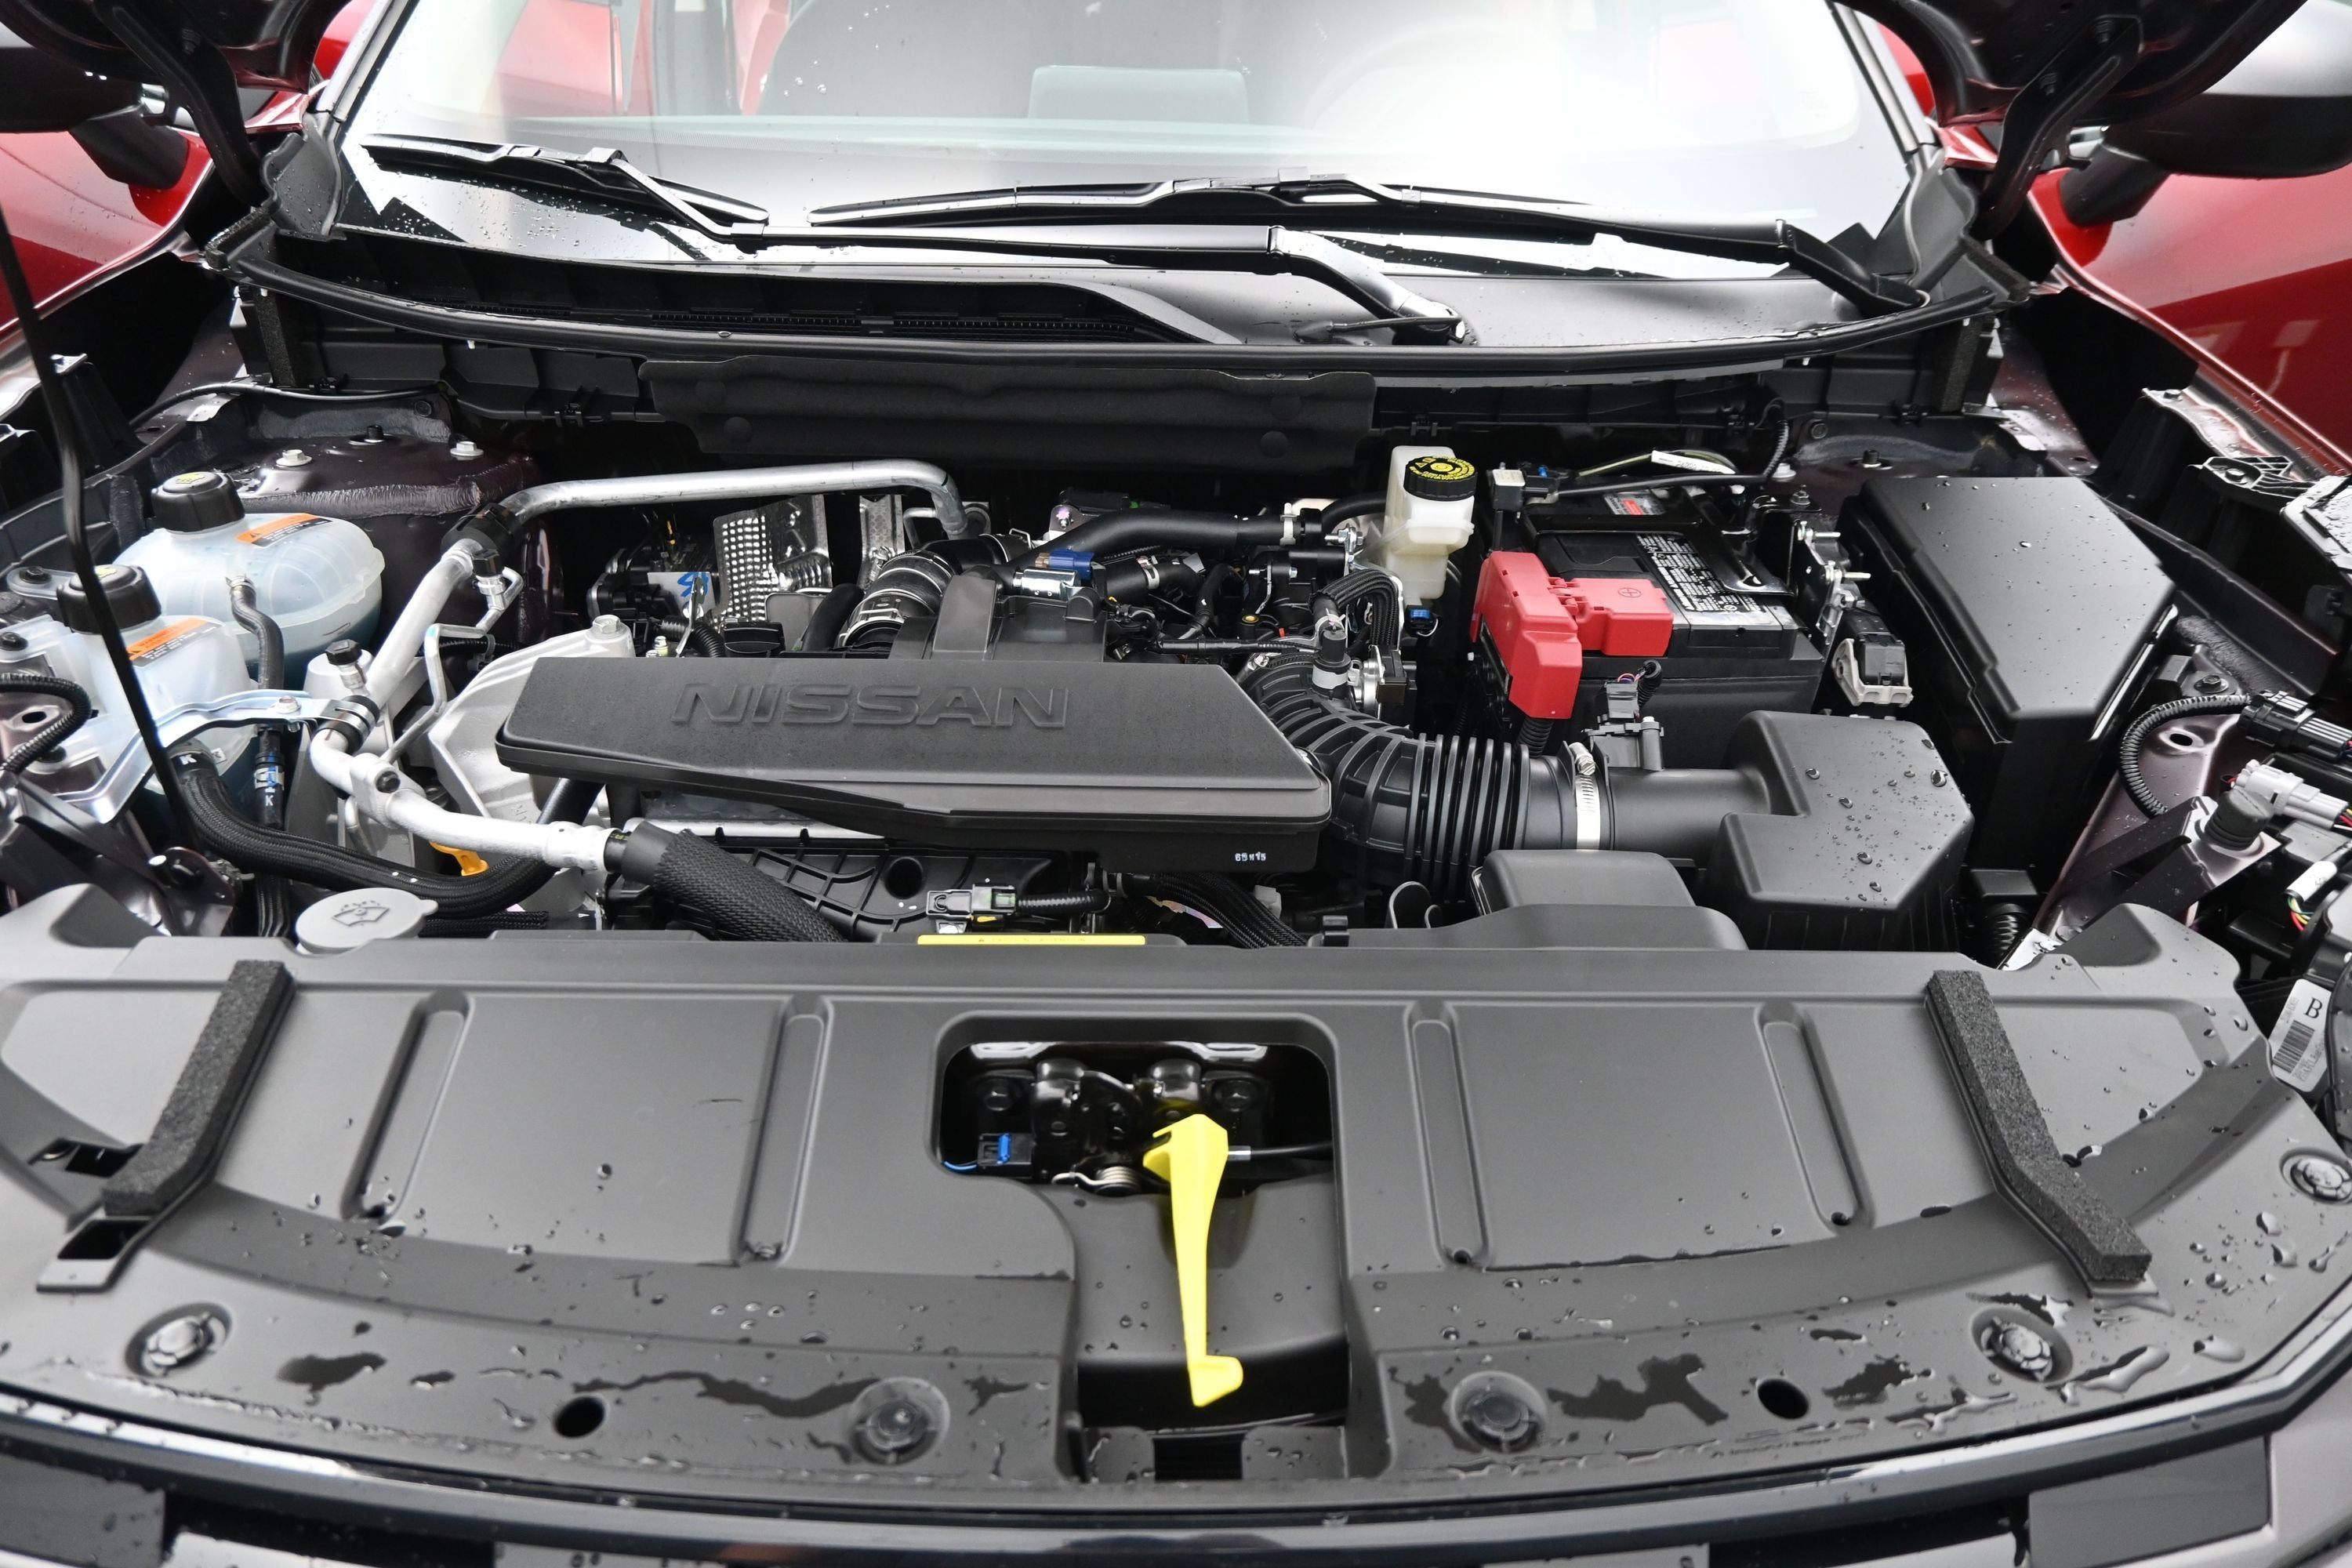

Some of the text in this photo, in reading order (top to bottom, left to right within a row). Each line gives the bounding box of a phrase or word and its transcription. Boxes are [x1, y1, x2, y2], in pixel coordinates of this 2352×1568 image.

[670, 683, 1069, 728] NISSAN
[179, 754, 197, 765] K
[265, 794, 274, 806] K
[2304, 996, 2323, 1018] B
